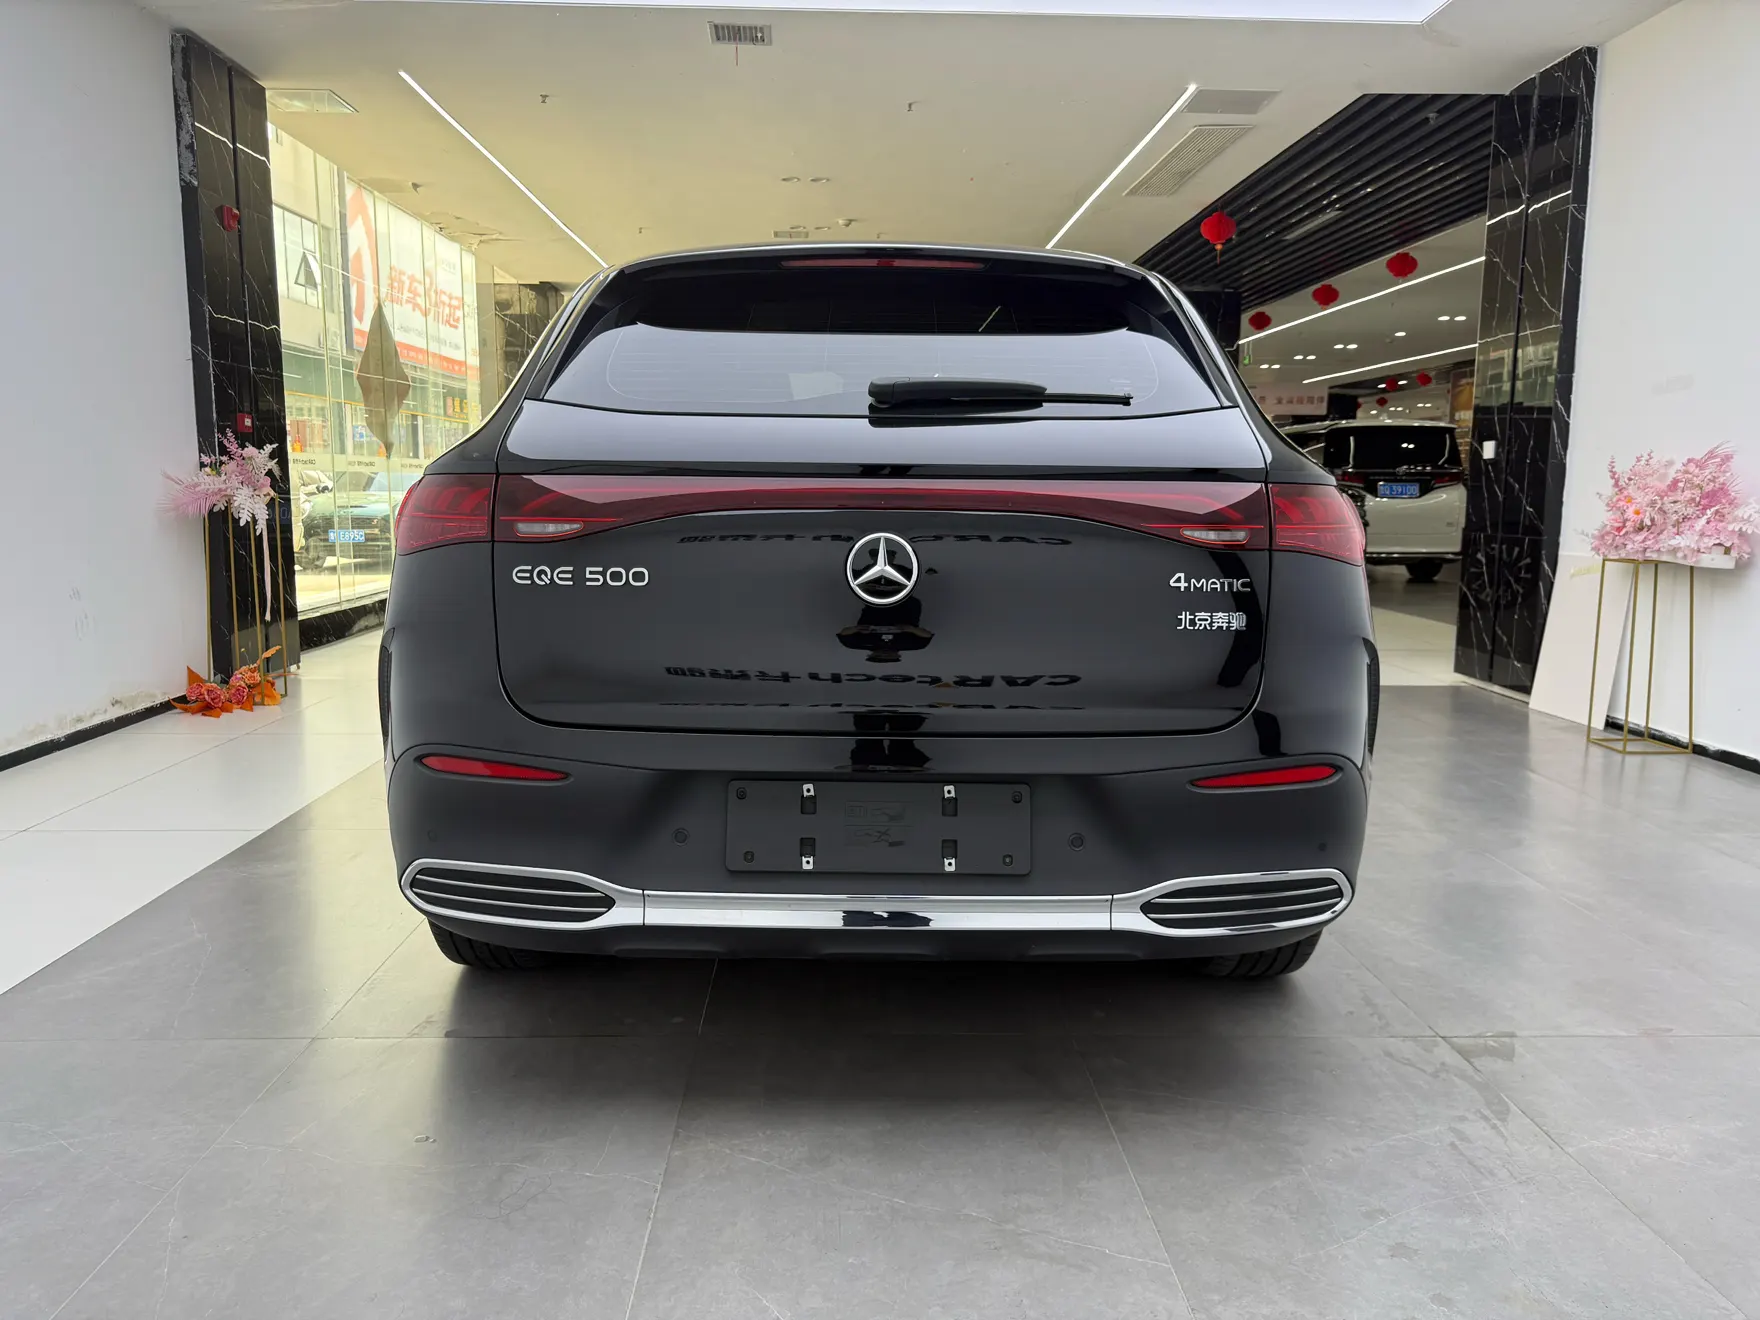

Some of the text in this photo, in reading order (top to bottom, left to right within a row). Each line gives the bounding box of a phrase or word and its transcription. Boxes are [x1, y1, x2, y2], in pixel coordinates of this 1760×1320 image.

[512, 565, 649, 586] EQE 500
[1169, 572, 1251, 592] 4MATIC
[1176, 611, 1246, 630] 北京奔驰
